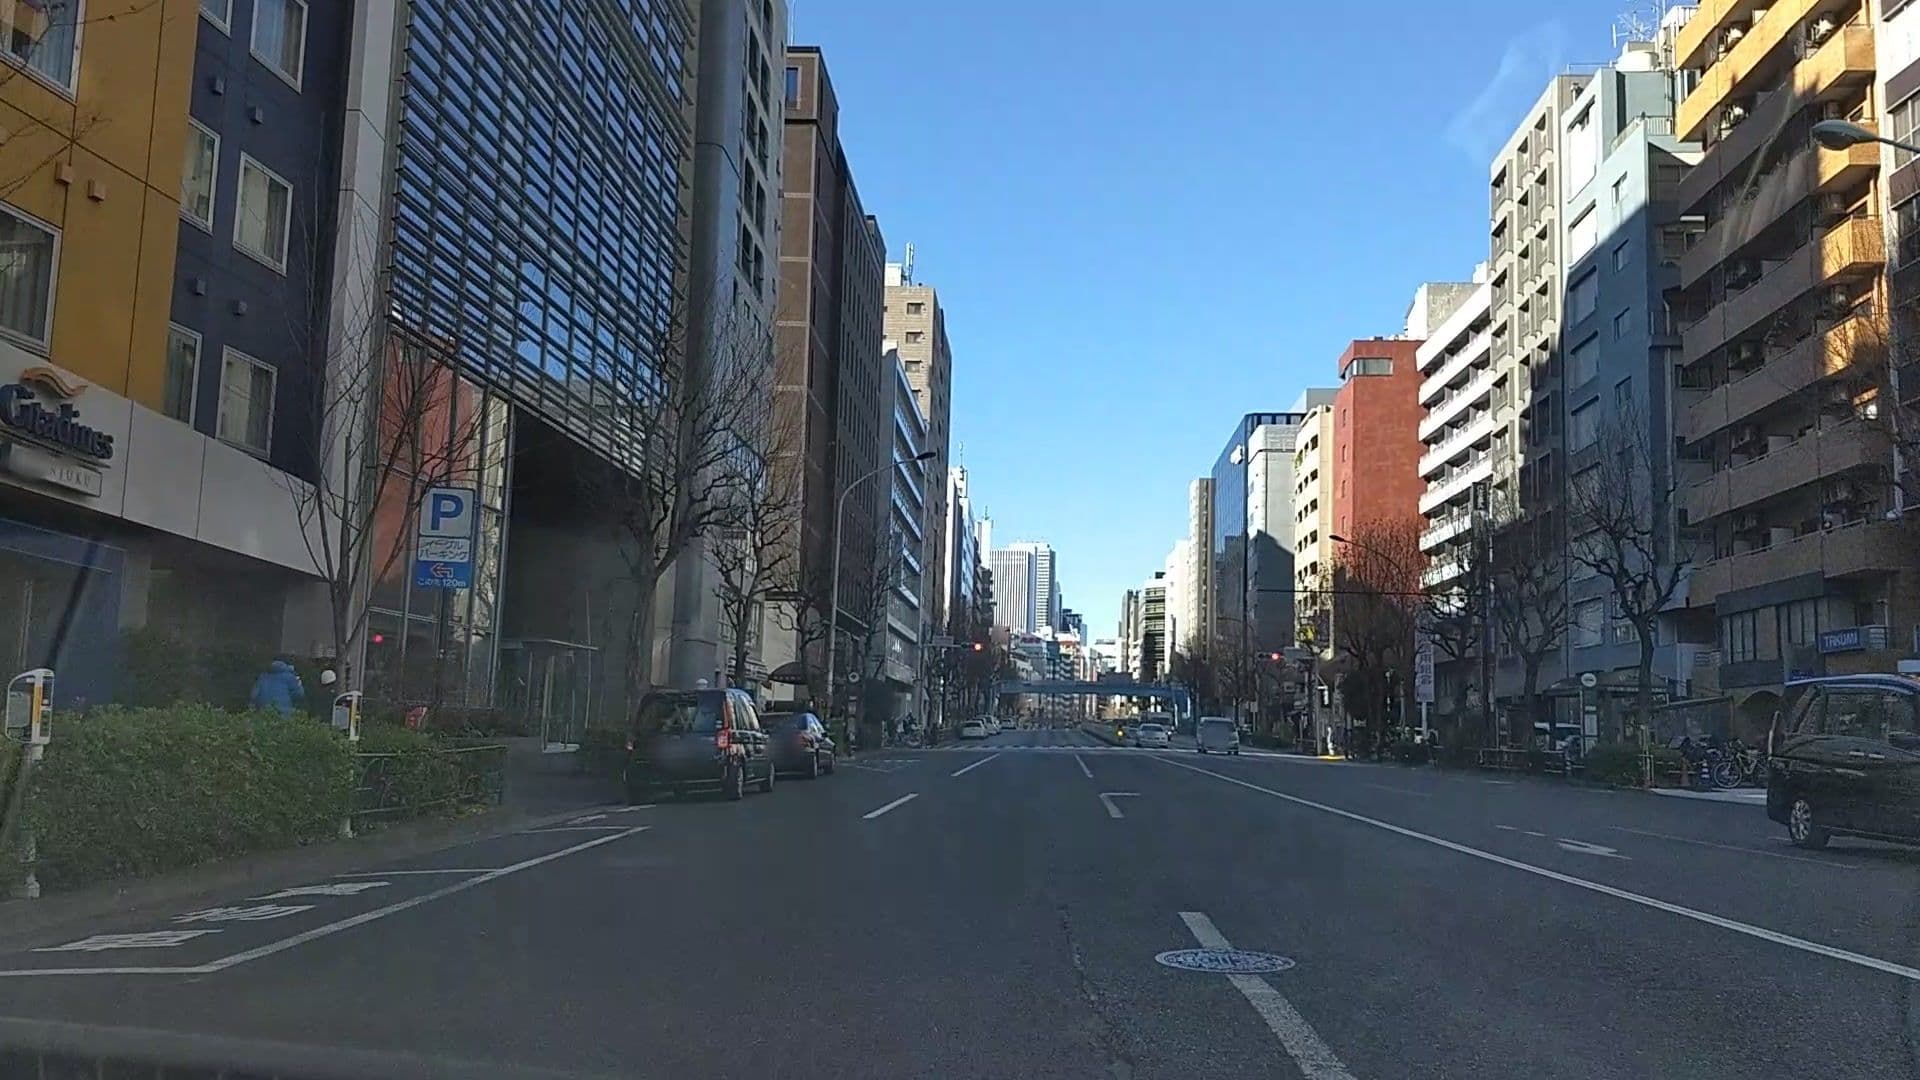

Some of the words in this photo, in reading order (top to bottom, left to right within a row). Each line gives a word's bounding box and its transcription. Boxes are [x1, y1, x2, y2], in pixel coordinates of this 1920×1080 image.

[431, 493, 464, 531] P
[420, 549, 468, 560] パーキング
